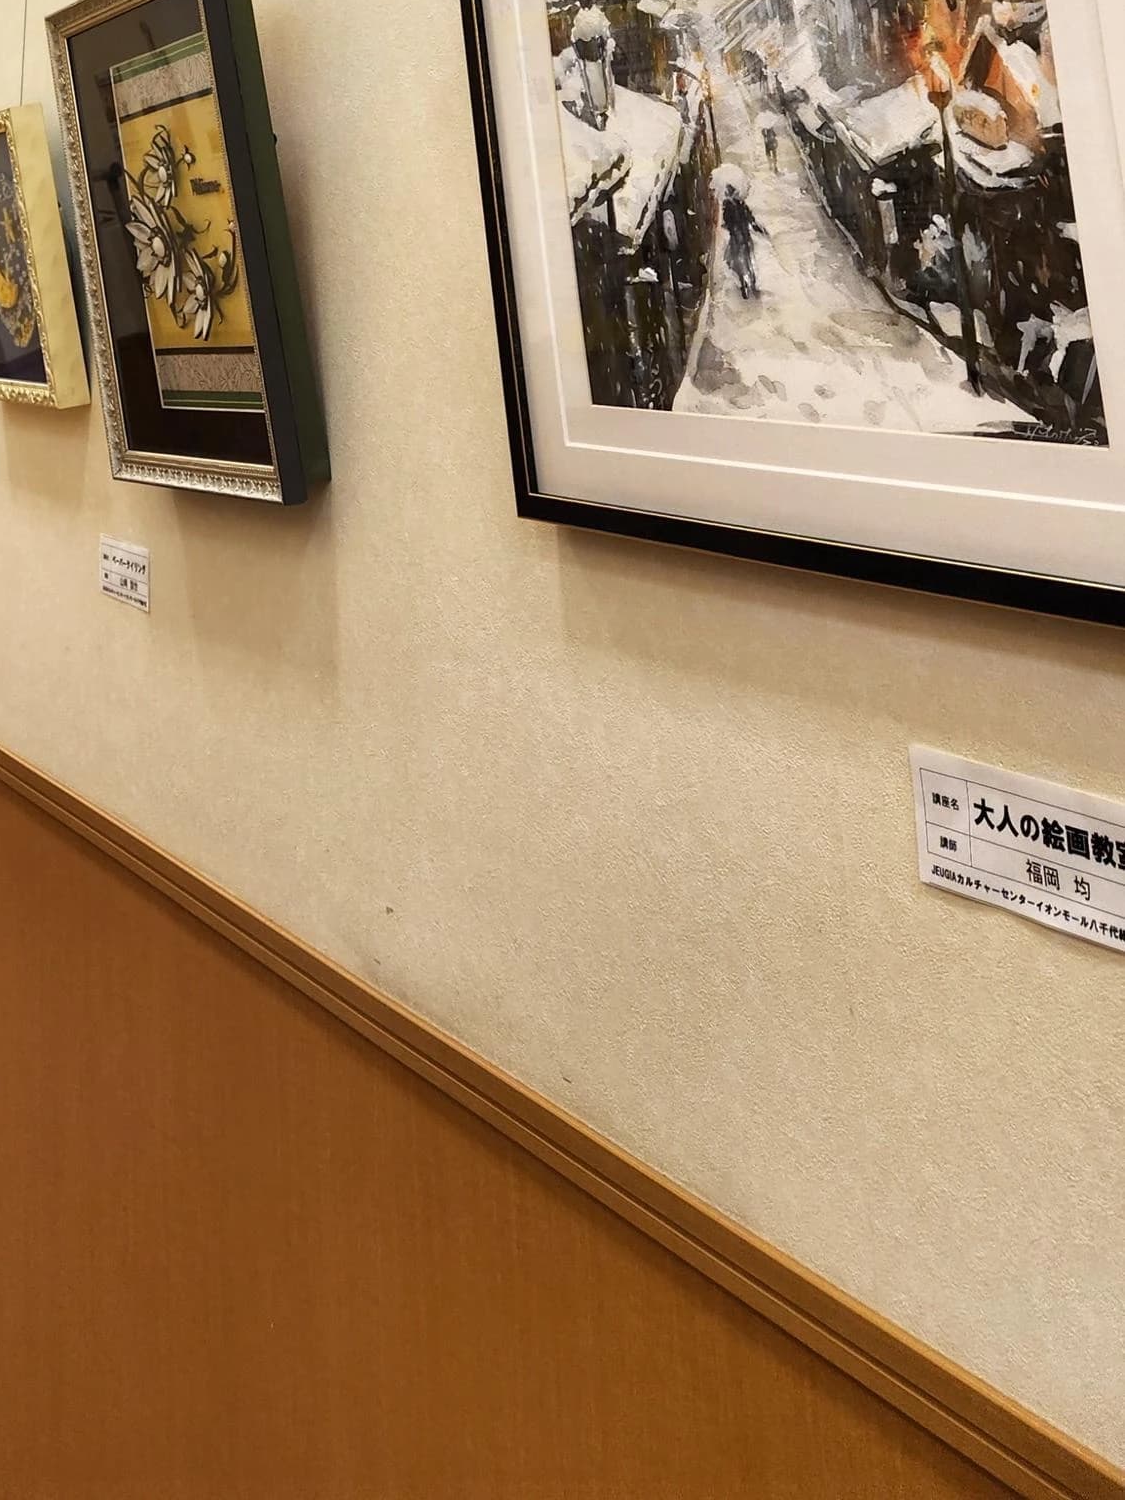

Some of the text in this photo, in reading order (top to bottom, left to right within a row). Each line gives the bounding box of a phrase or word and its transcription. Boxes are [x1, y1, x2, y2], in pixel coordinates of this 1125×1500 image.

[931, 791, 960, 811] 講座名
[939, 835, 958, 853] 講師
[1025, 858, 1091, 901] 福岡 均
